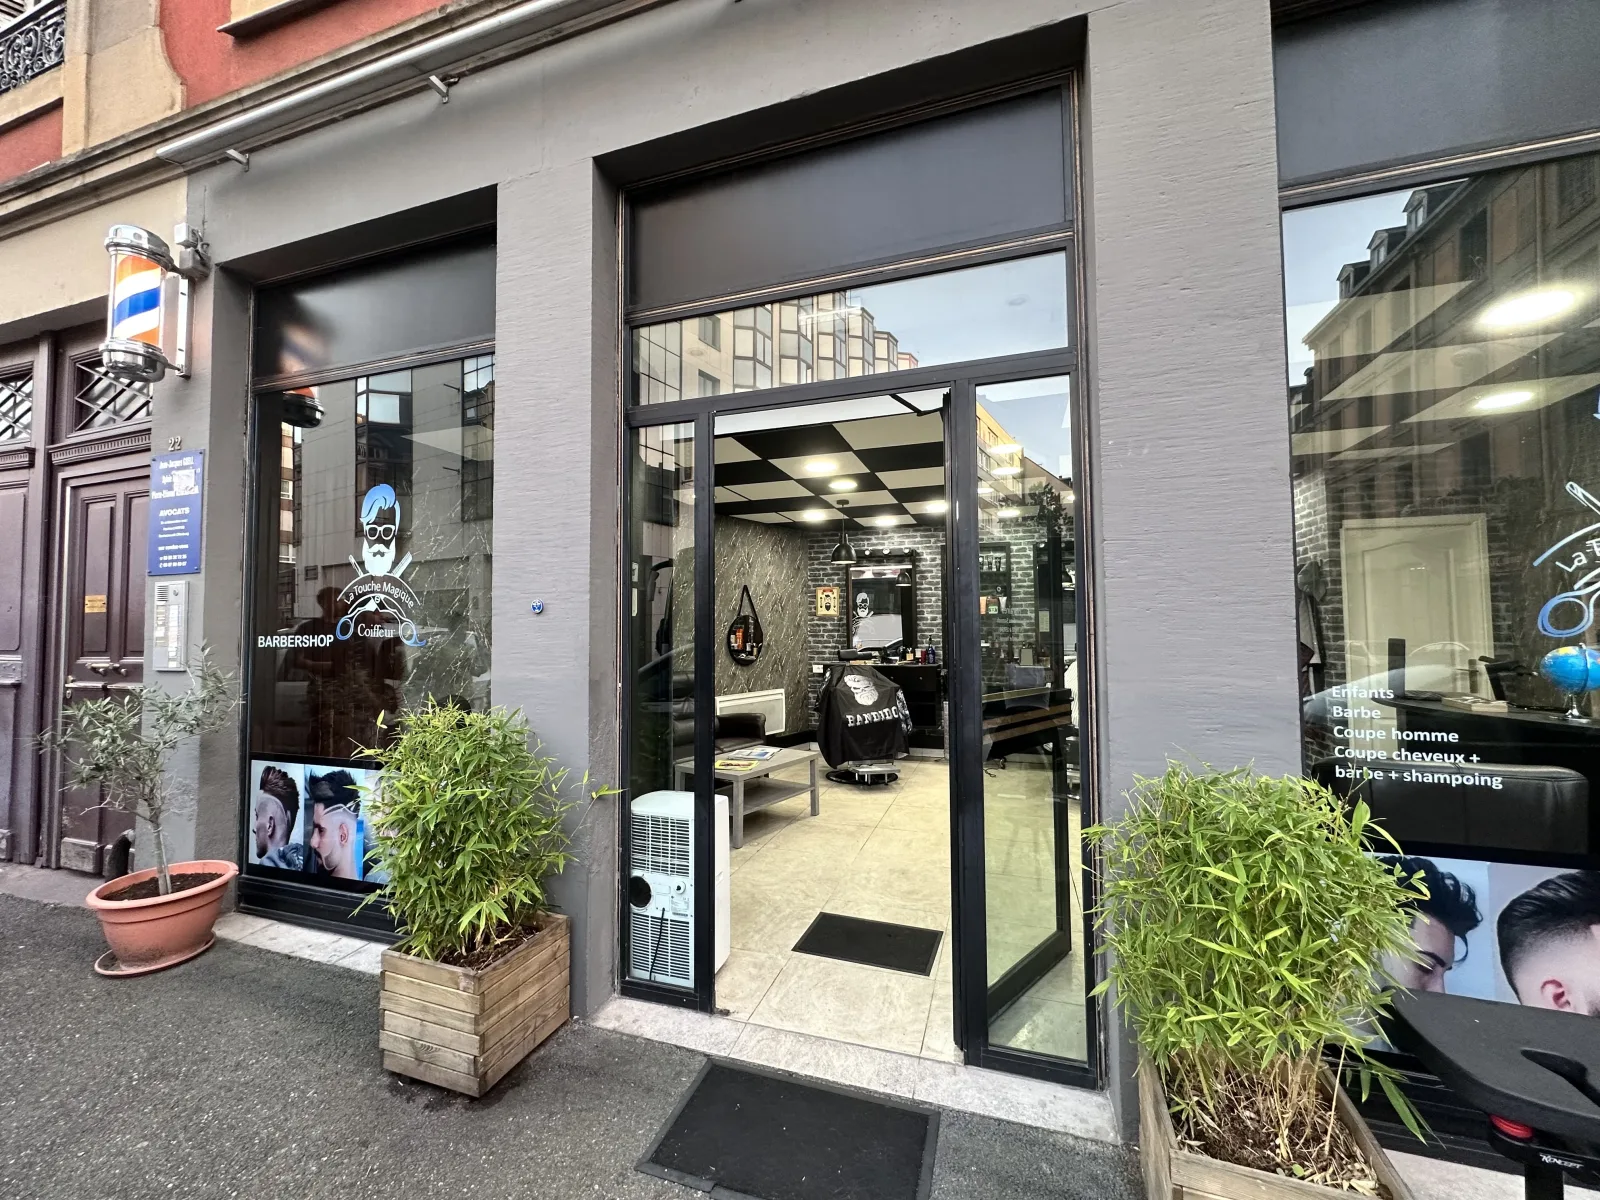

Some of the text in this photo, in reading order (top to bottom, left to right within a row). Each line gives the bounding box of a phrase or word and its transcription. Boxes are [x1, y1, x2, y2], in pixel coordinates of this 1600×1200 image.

[168, 436, 181, 451] 22
[159, 507, 190, 516] AVOCATS
[1555, 552, 1587, 572] La
[344, 581, 414, 609] La Touche Magique
[357, 623, 396, 638] Coiffeur
[258, 634, 334, 648] BARBERSHOP
[1331, 686, 1394, 700] Enfants
[846, 706, 899, 727] BANDIDO
[1332, 705, 1381, 719] Barbe
[1333, 725, 1459, 742] Coupe homme
[1334, 745, 1387, 762] Coupe
[1392, 747, 1465, 763] cheveux
[1403, 769, 1502, 789] shampoing
